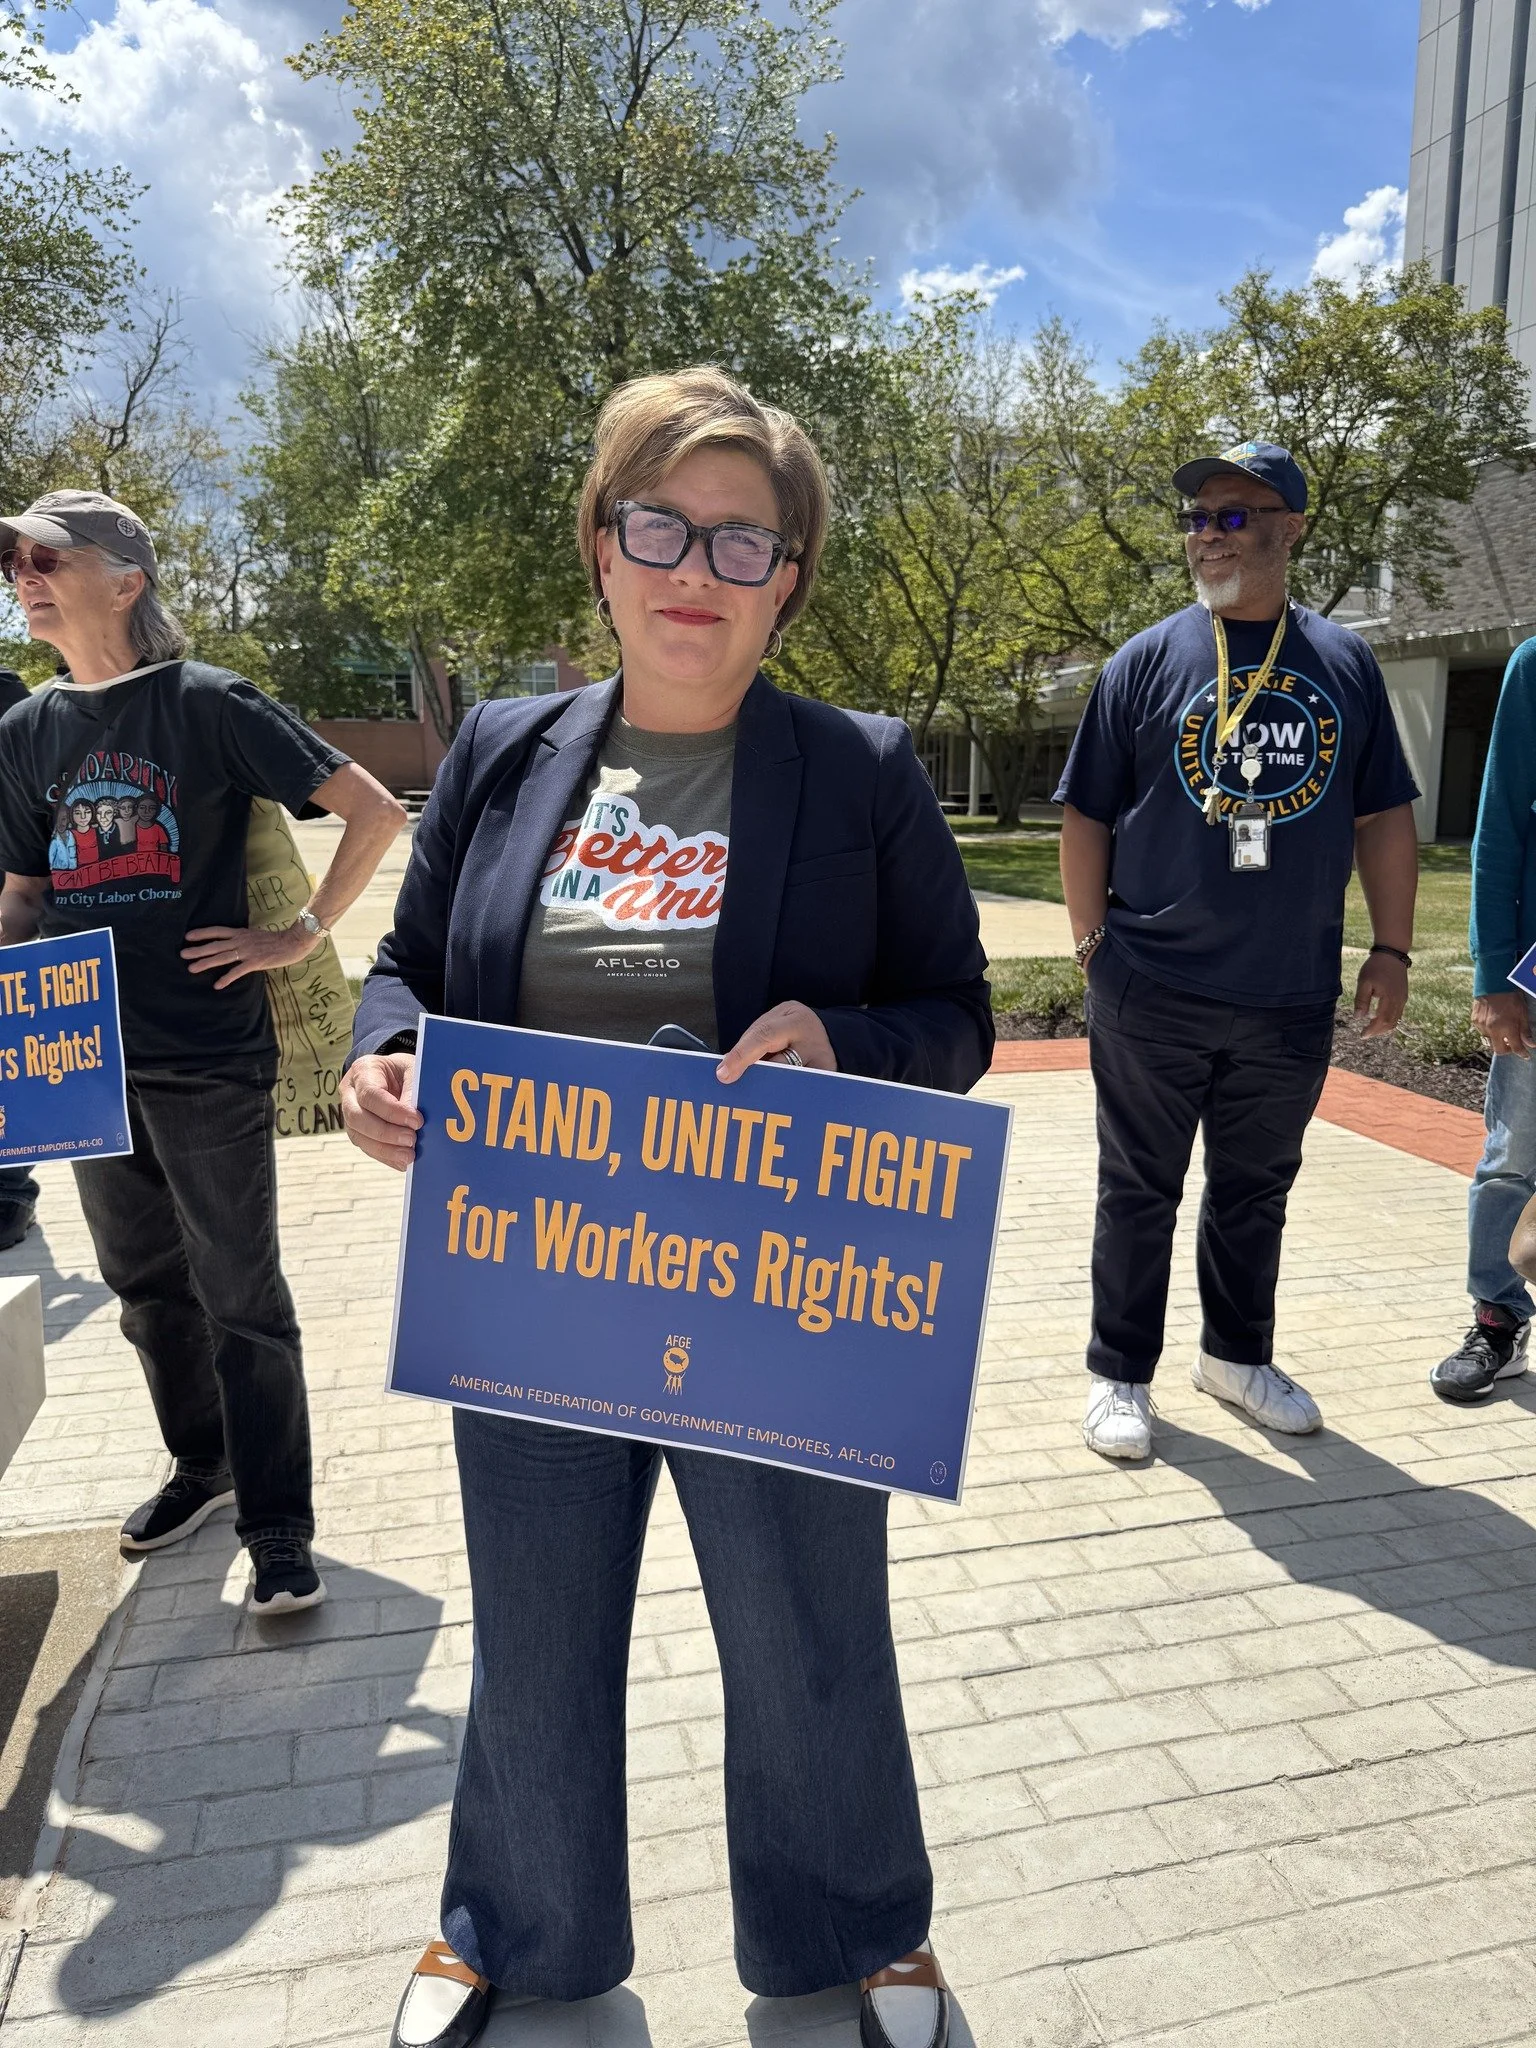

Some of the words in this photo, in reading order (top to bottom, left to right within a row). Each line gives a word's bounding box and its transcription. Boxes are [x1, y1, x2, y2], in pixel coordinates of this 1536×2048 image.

[1182, 714, 1205, 787] UNITE
[1318, 716, 1337, 764] ACT
[1231, 752, 1262, 765] TE
[1266, 752, 1305, 766] TIME
[584, 802, 629, 837] IT'S
[99, 860, 121, 881] BE
[70, 892, 95, 908] City
[98, 891, 136, 904] Labor
[139, 888, 182, 901] Chorus
[551, 869, 582, 899] IN
[583, 873, 601, 900] A
[602, 874, 726, 920] Uni
[594, 957, 681, 969] AFL-CIO
[0, 970, 36, 1019] TE,
[39, 957, 101, 1010] FIGHT
[307, 974, 341, 1008] WE
[24, 1024, 103, 1085] Rights!
[78, 1138, 103, 1147] AFL-CIO
[445, 1067, 622, 1177] STAND,
[640, 1095, 799, 1203] UNITE,
[817, 1121, 973, 1220] FIGHT
[446, 1184, 519, 1263] for
[534, 1196, 740, 1299] Workers
[753, 1230, 943, 1337] Rights!
[665, 1334, 692, 1349] AFGE
[449, 1373, 524, 1399] AMERICAN
[527, 1388, 613, 1415] FEDERATION
[617, 1404, 637, 1419] OF
[640, 1407, 745, 1438] GOVERNMENT
[747, 1426, 835, 1459] EMPLOYEES,
[837, 1446, 896, 1471] AFL-CIO
